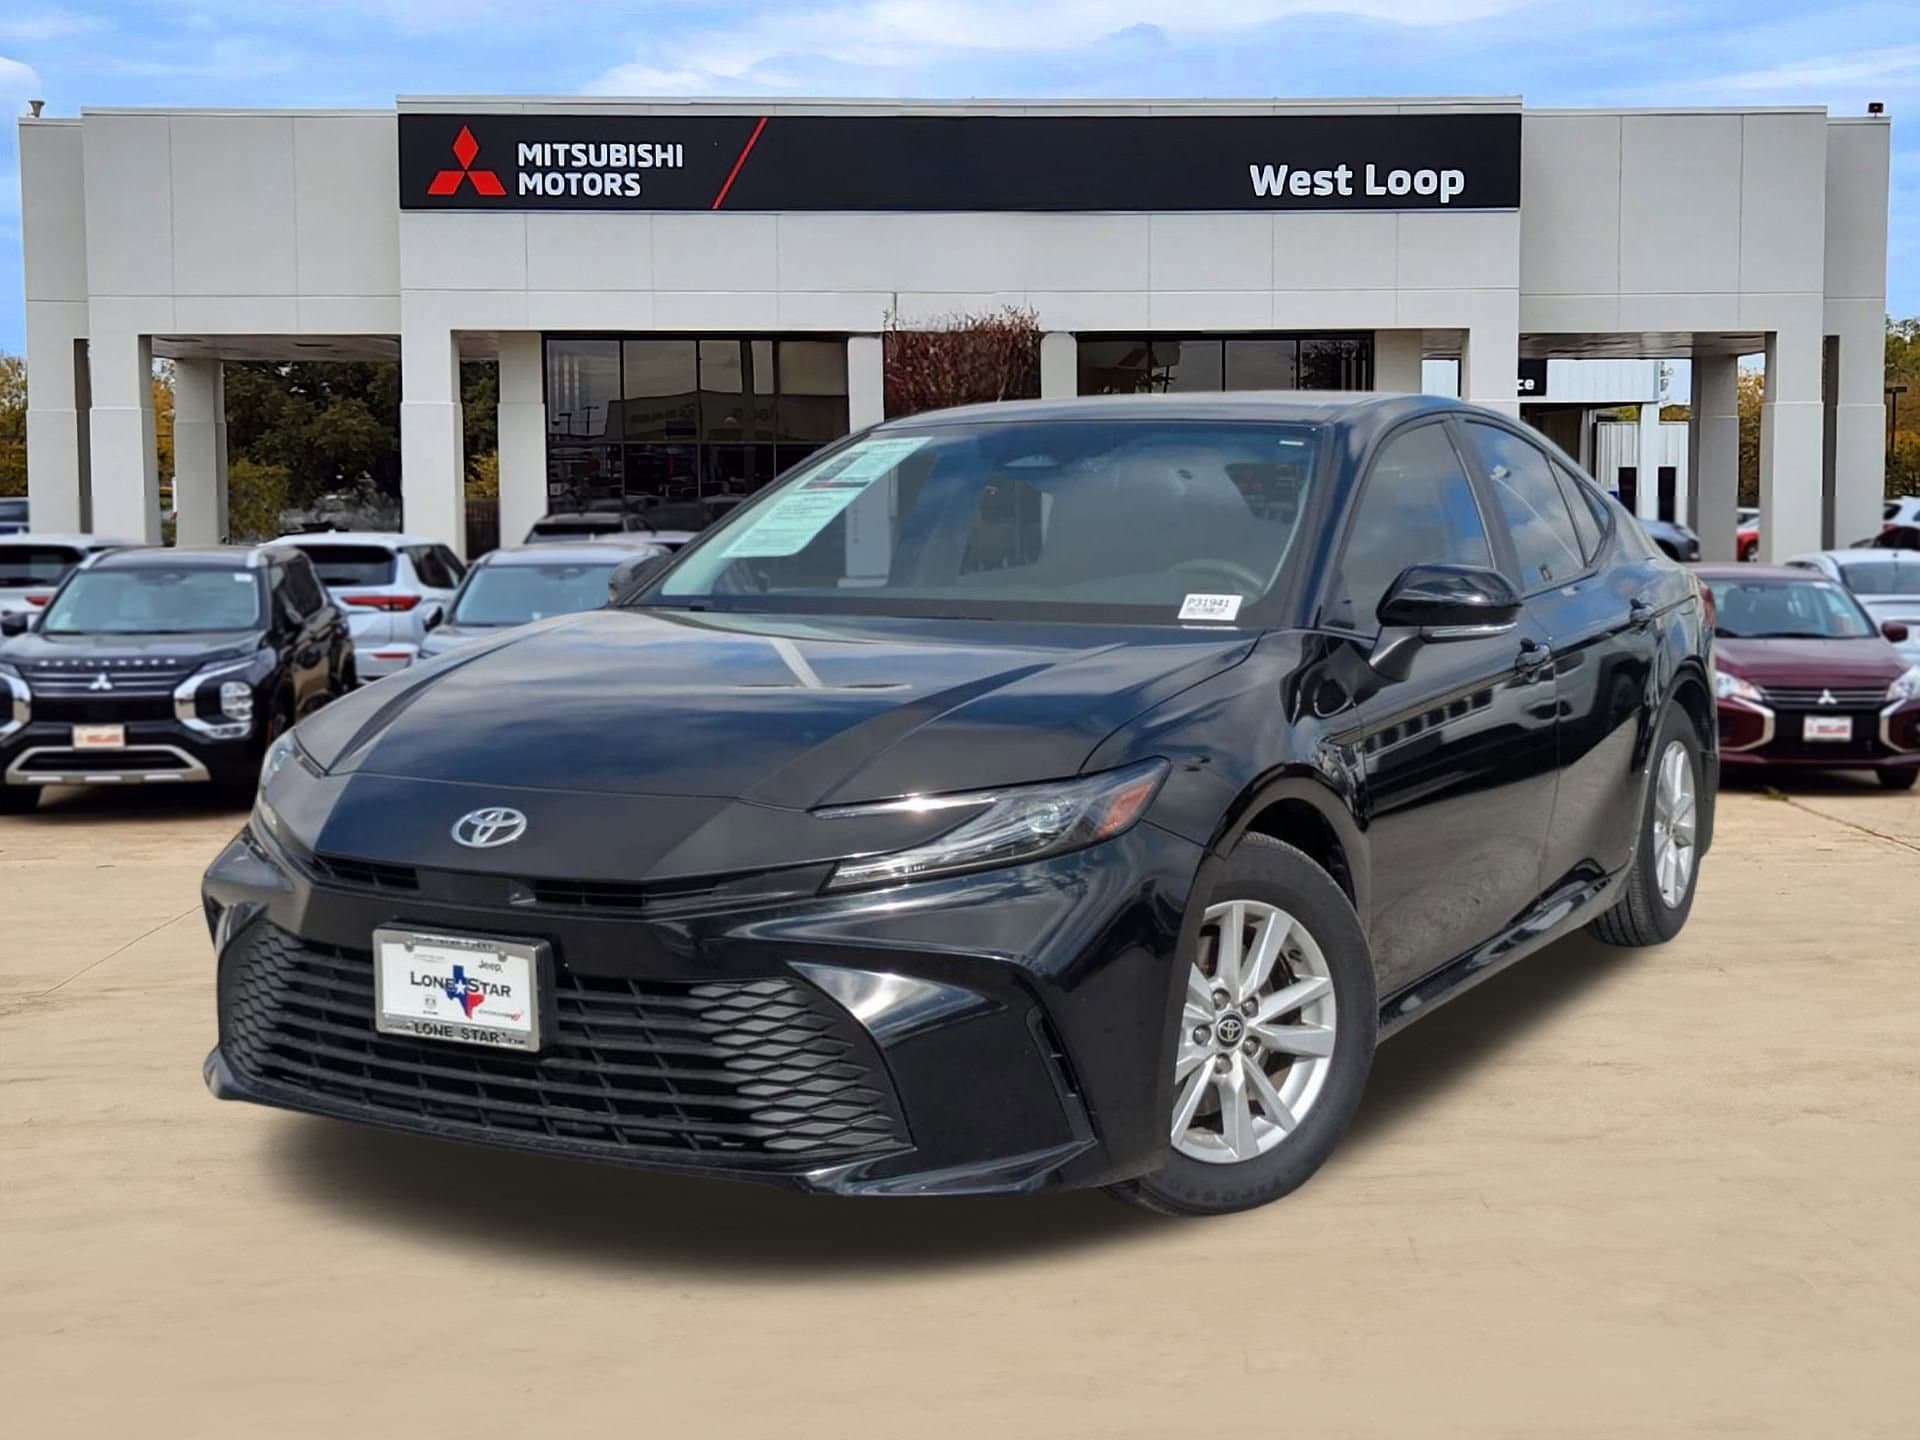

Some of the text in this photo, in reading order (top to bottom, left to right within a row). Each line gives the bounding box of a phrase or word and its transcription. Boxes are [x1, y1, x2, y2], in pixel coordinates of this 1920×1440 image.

[518, 143, 684, 168] MITSUBISHI
[518, 172, 641, 197] MOTORS
[1249, 164, 1465, 203] West Loop
[1187, 598, 1230, 608] P31941
[411, 971, 511, 998] LONE STAR
[414, 1023, 454, 1037] LONE
[461, 1028, 500, 1044] STAR
